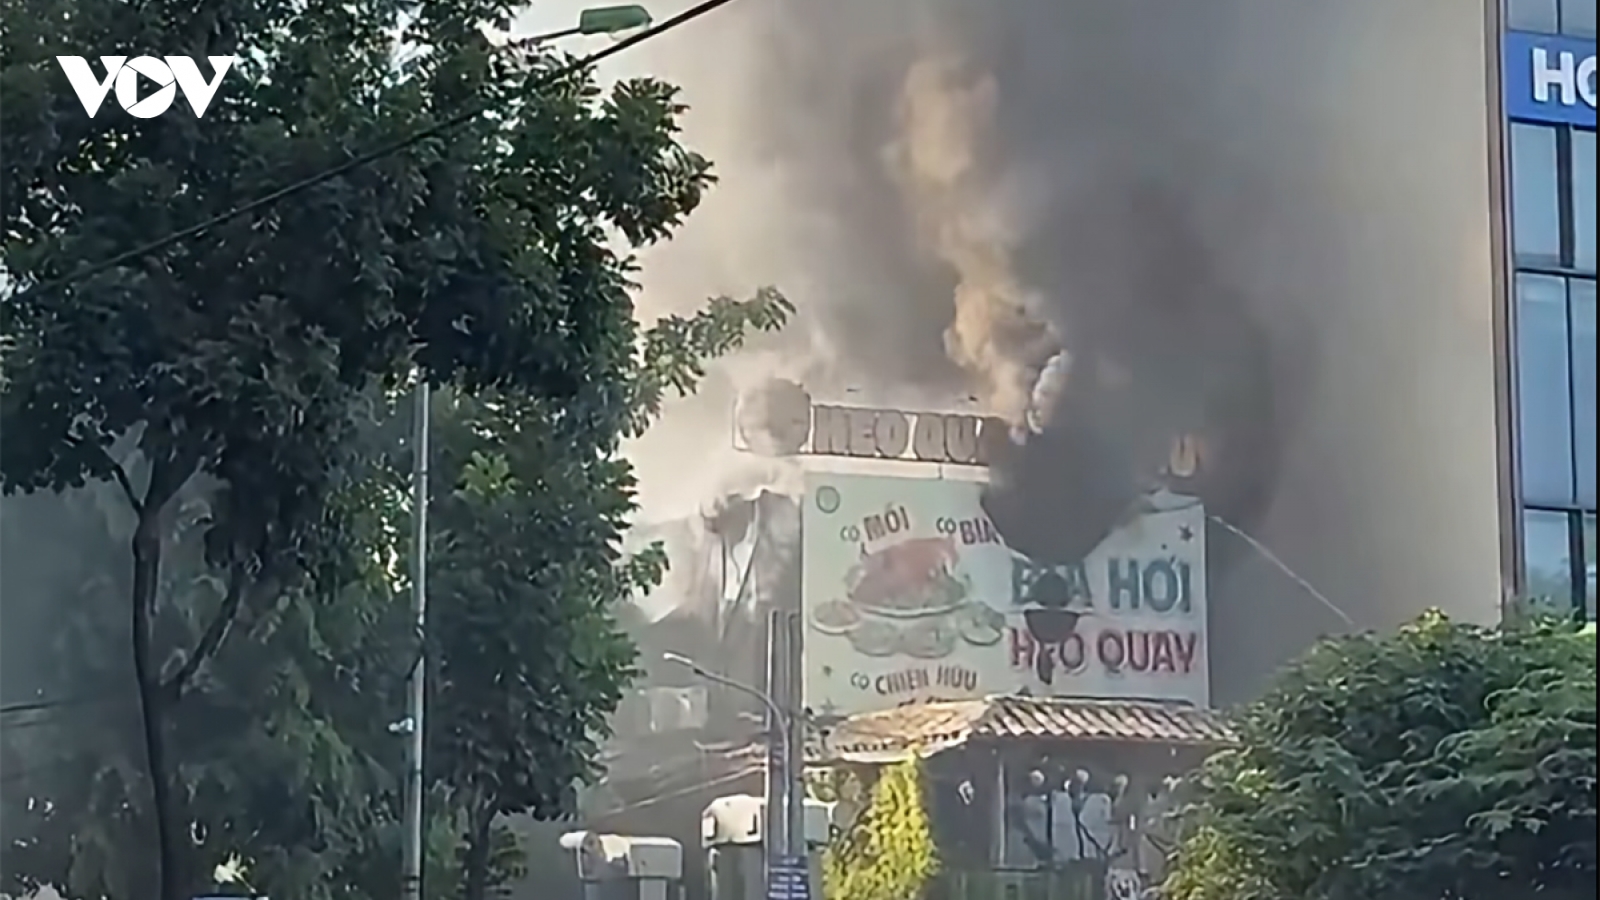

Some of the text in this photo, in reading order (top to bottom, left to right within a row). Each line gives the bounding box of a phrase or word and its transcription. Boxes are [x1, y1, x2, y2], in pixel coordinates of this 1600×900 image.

[1012, 558, 1094, 608] BA
[1010, 628, 1197, 674] HO QUAY
